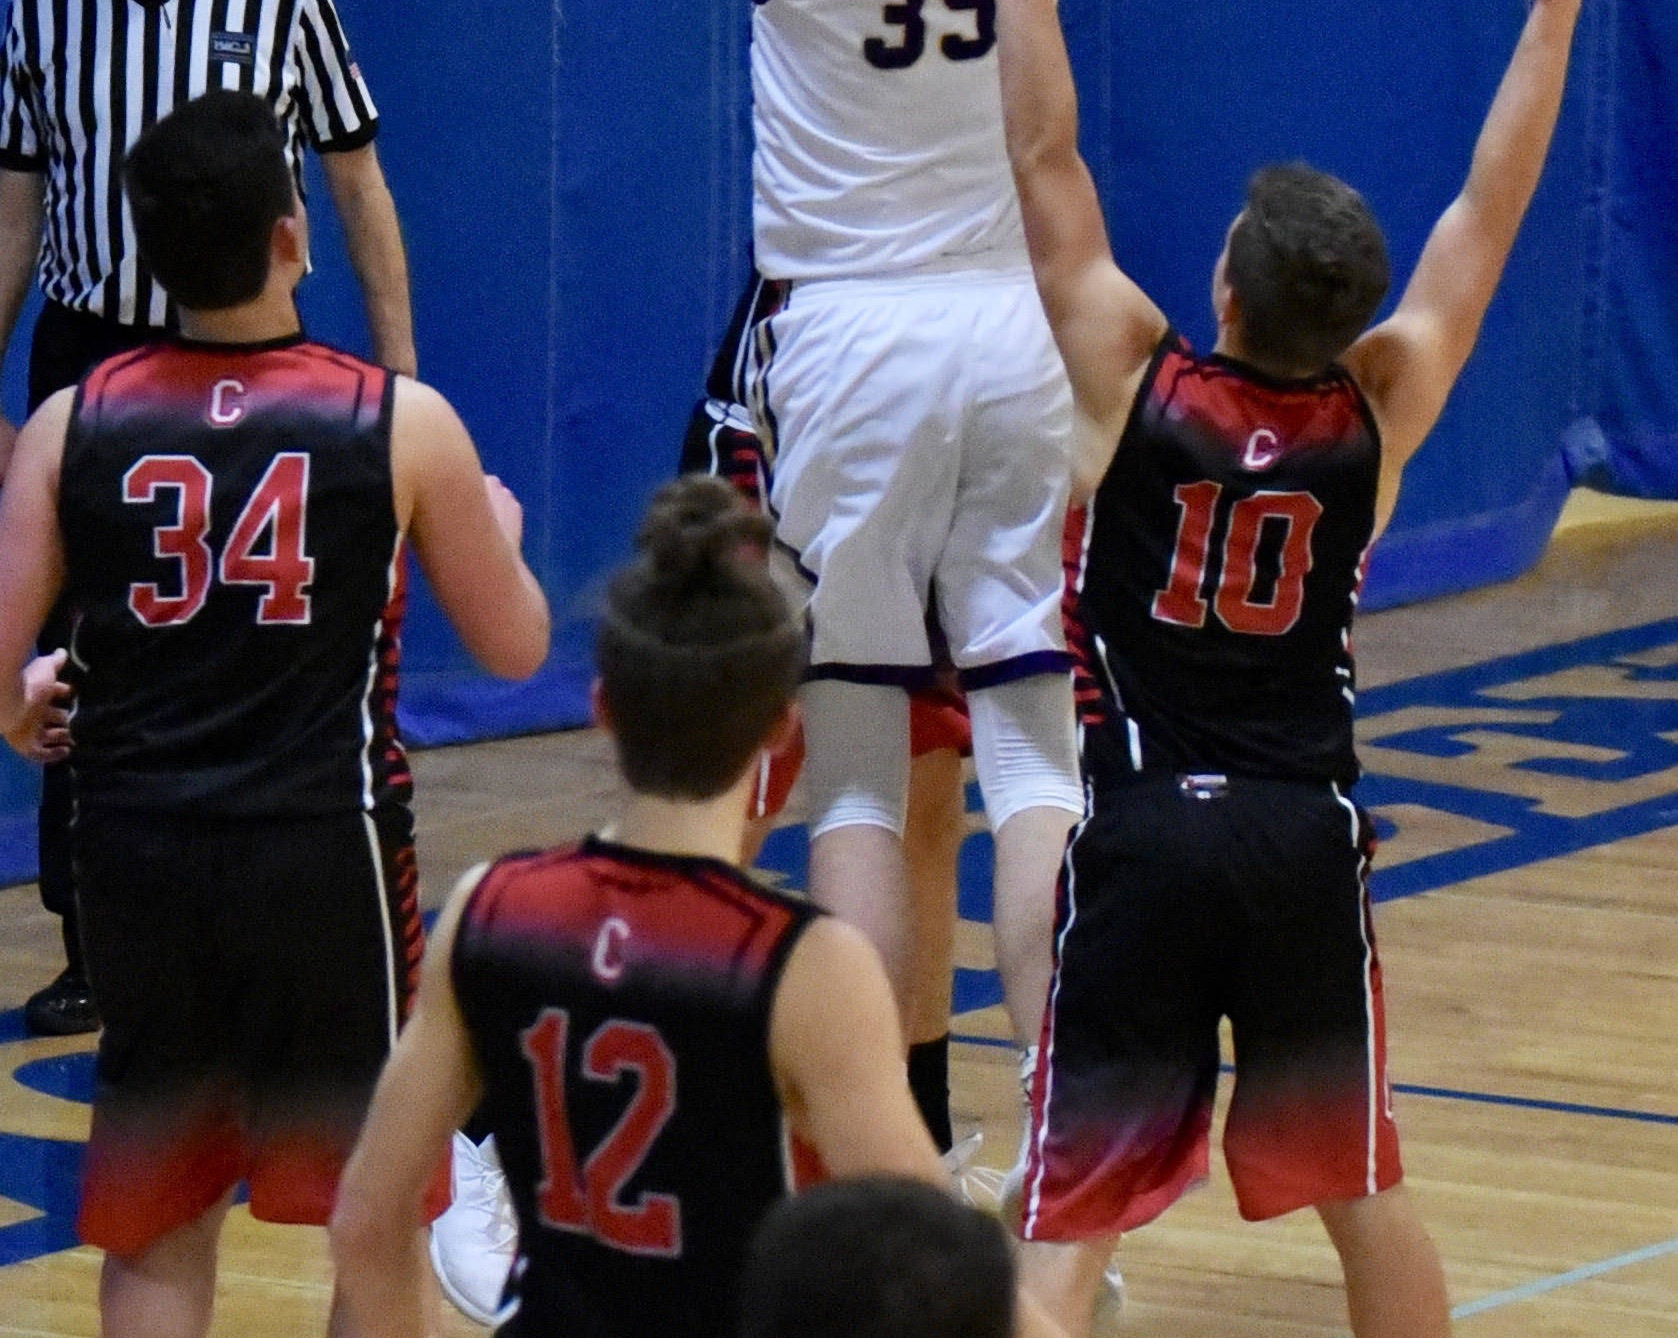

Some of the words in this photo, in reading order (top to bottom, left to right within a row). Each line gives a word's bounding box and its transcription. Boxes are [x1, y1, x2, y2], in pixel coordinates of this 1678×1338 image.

[209, 378, 245, 426] C
[1243, 427, 1279, 469] C
[122, 452, 315, 627] 34
[1150, 479, 1324, 635] 10
[592, 915, 630, 982] C
[520, 1007, 683, 1258] 12
